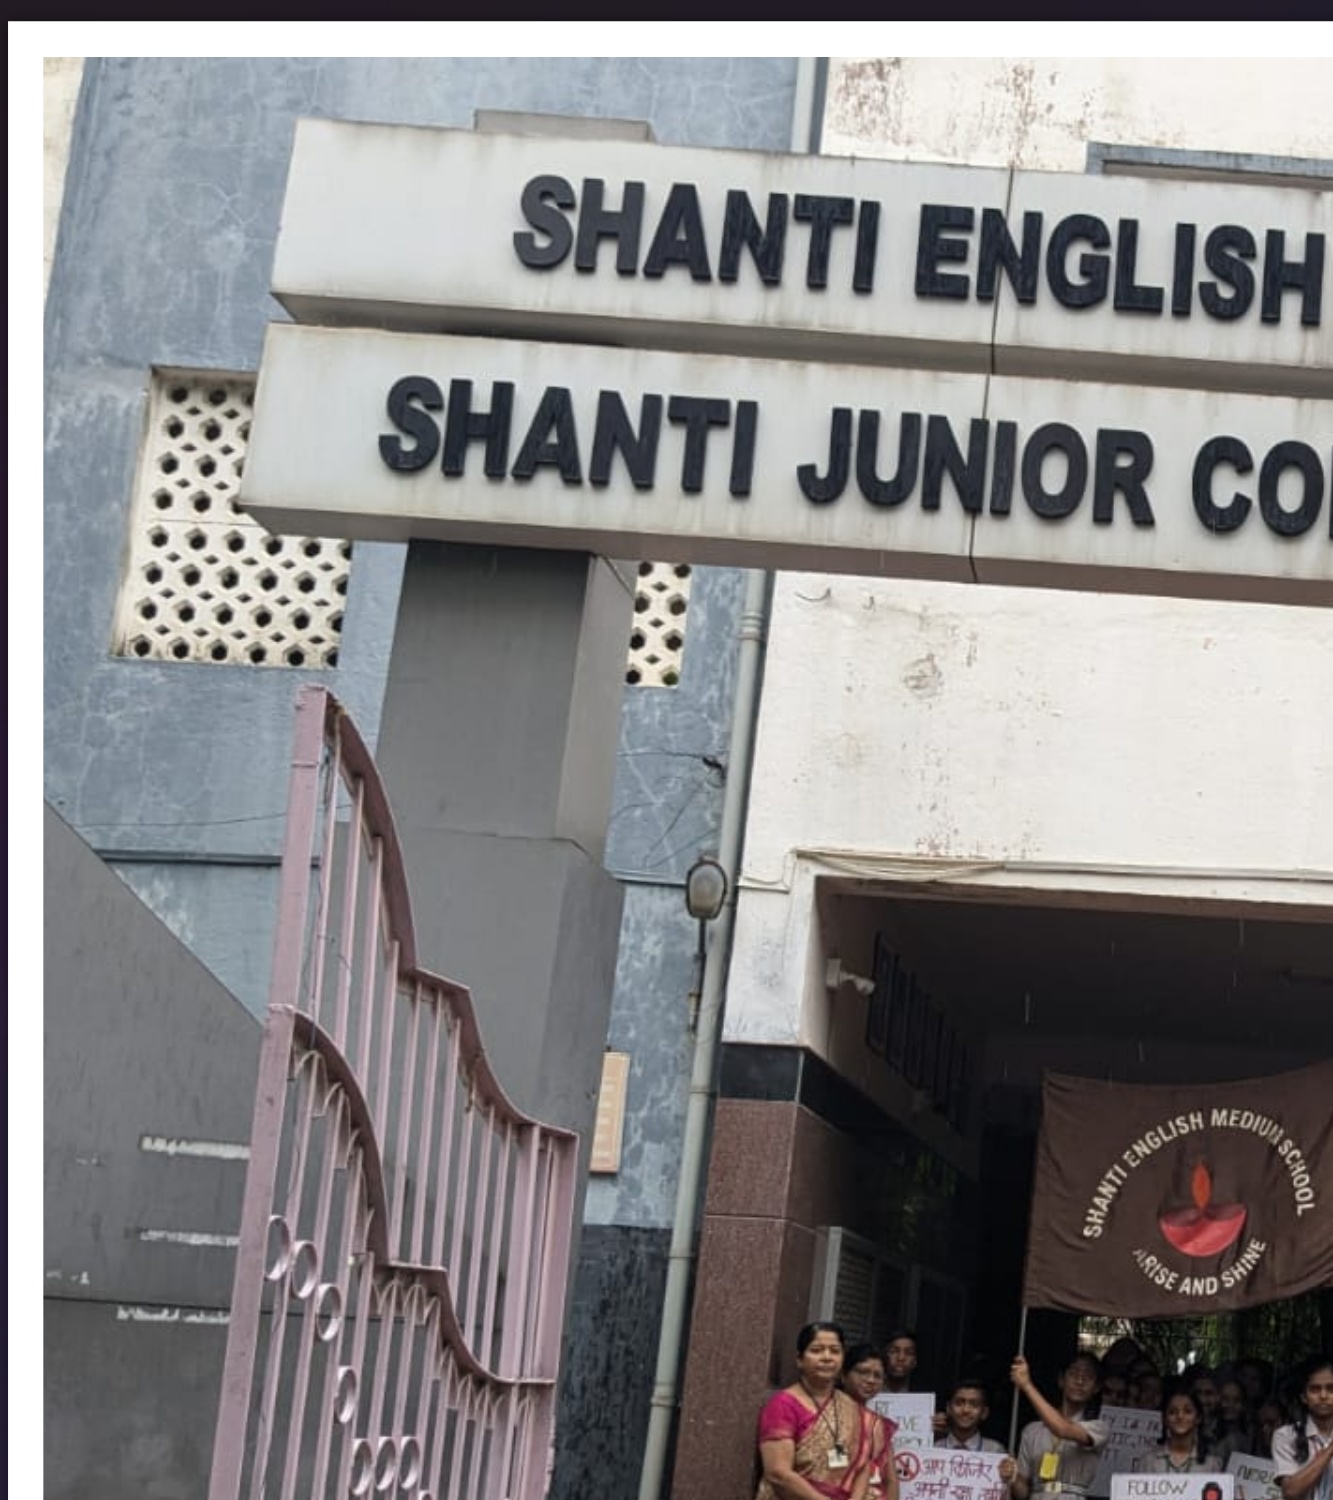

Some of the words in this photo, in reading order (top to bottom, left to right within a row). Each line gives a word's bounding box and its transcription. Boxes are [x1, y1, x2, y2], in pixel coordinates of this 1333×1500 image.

[512, 174, 880, 293] SHANTI
[915, 203, 1326, 327] ENGLISH
[378, 374, 758, 496] SHANTI
[797, 406, 1155, 528] JUNIOR
[1083, 1164, 1128, 1239] SHANTI
[1122, 1112, 1204, 1168] ENGLISH
[1211, 1107, 1286, 1146] MEDIUM
[1277, 1138, 1316, 1217] SCHOOL
[1132, 1248, 1179, 1290] ARISE
[1179, 1276, 1218, 1296] AND
[1222, 1238, 1267, 1288] SHINE
[922, 1458, 947, 1476] आप
[1128, 1480, 1188, 1496] FOLLOW
